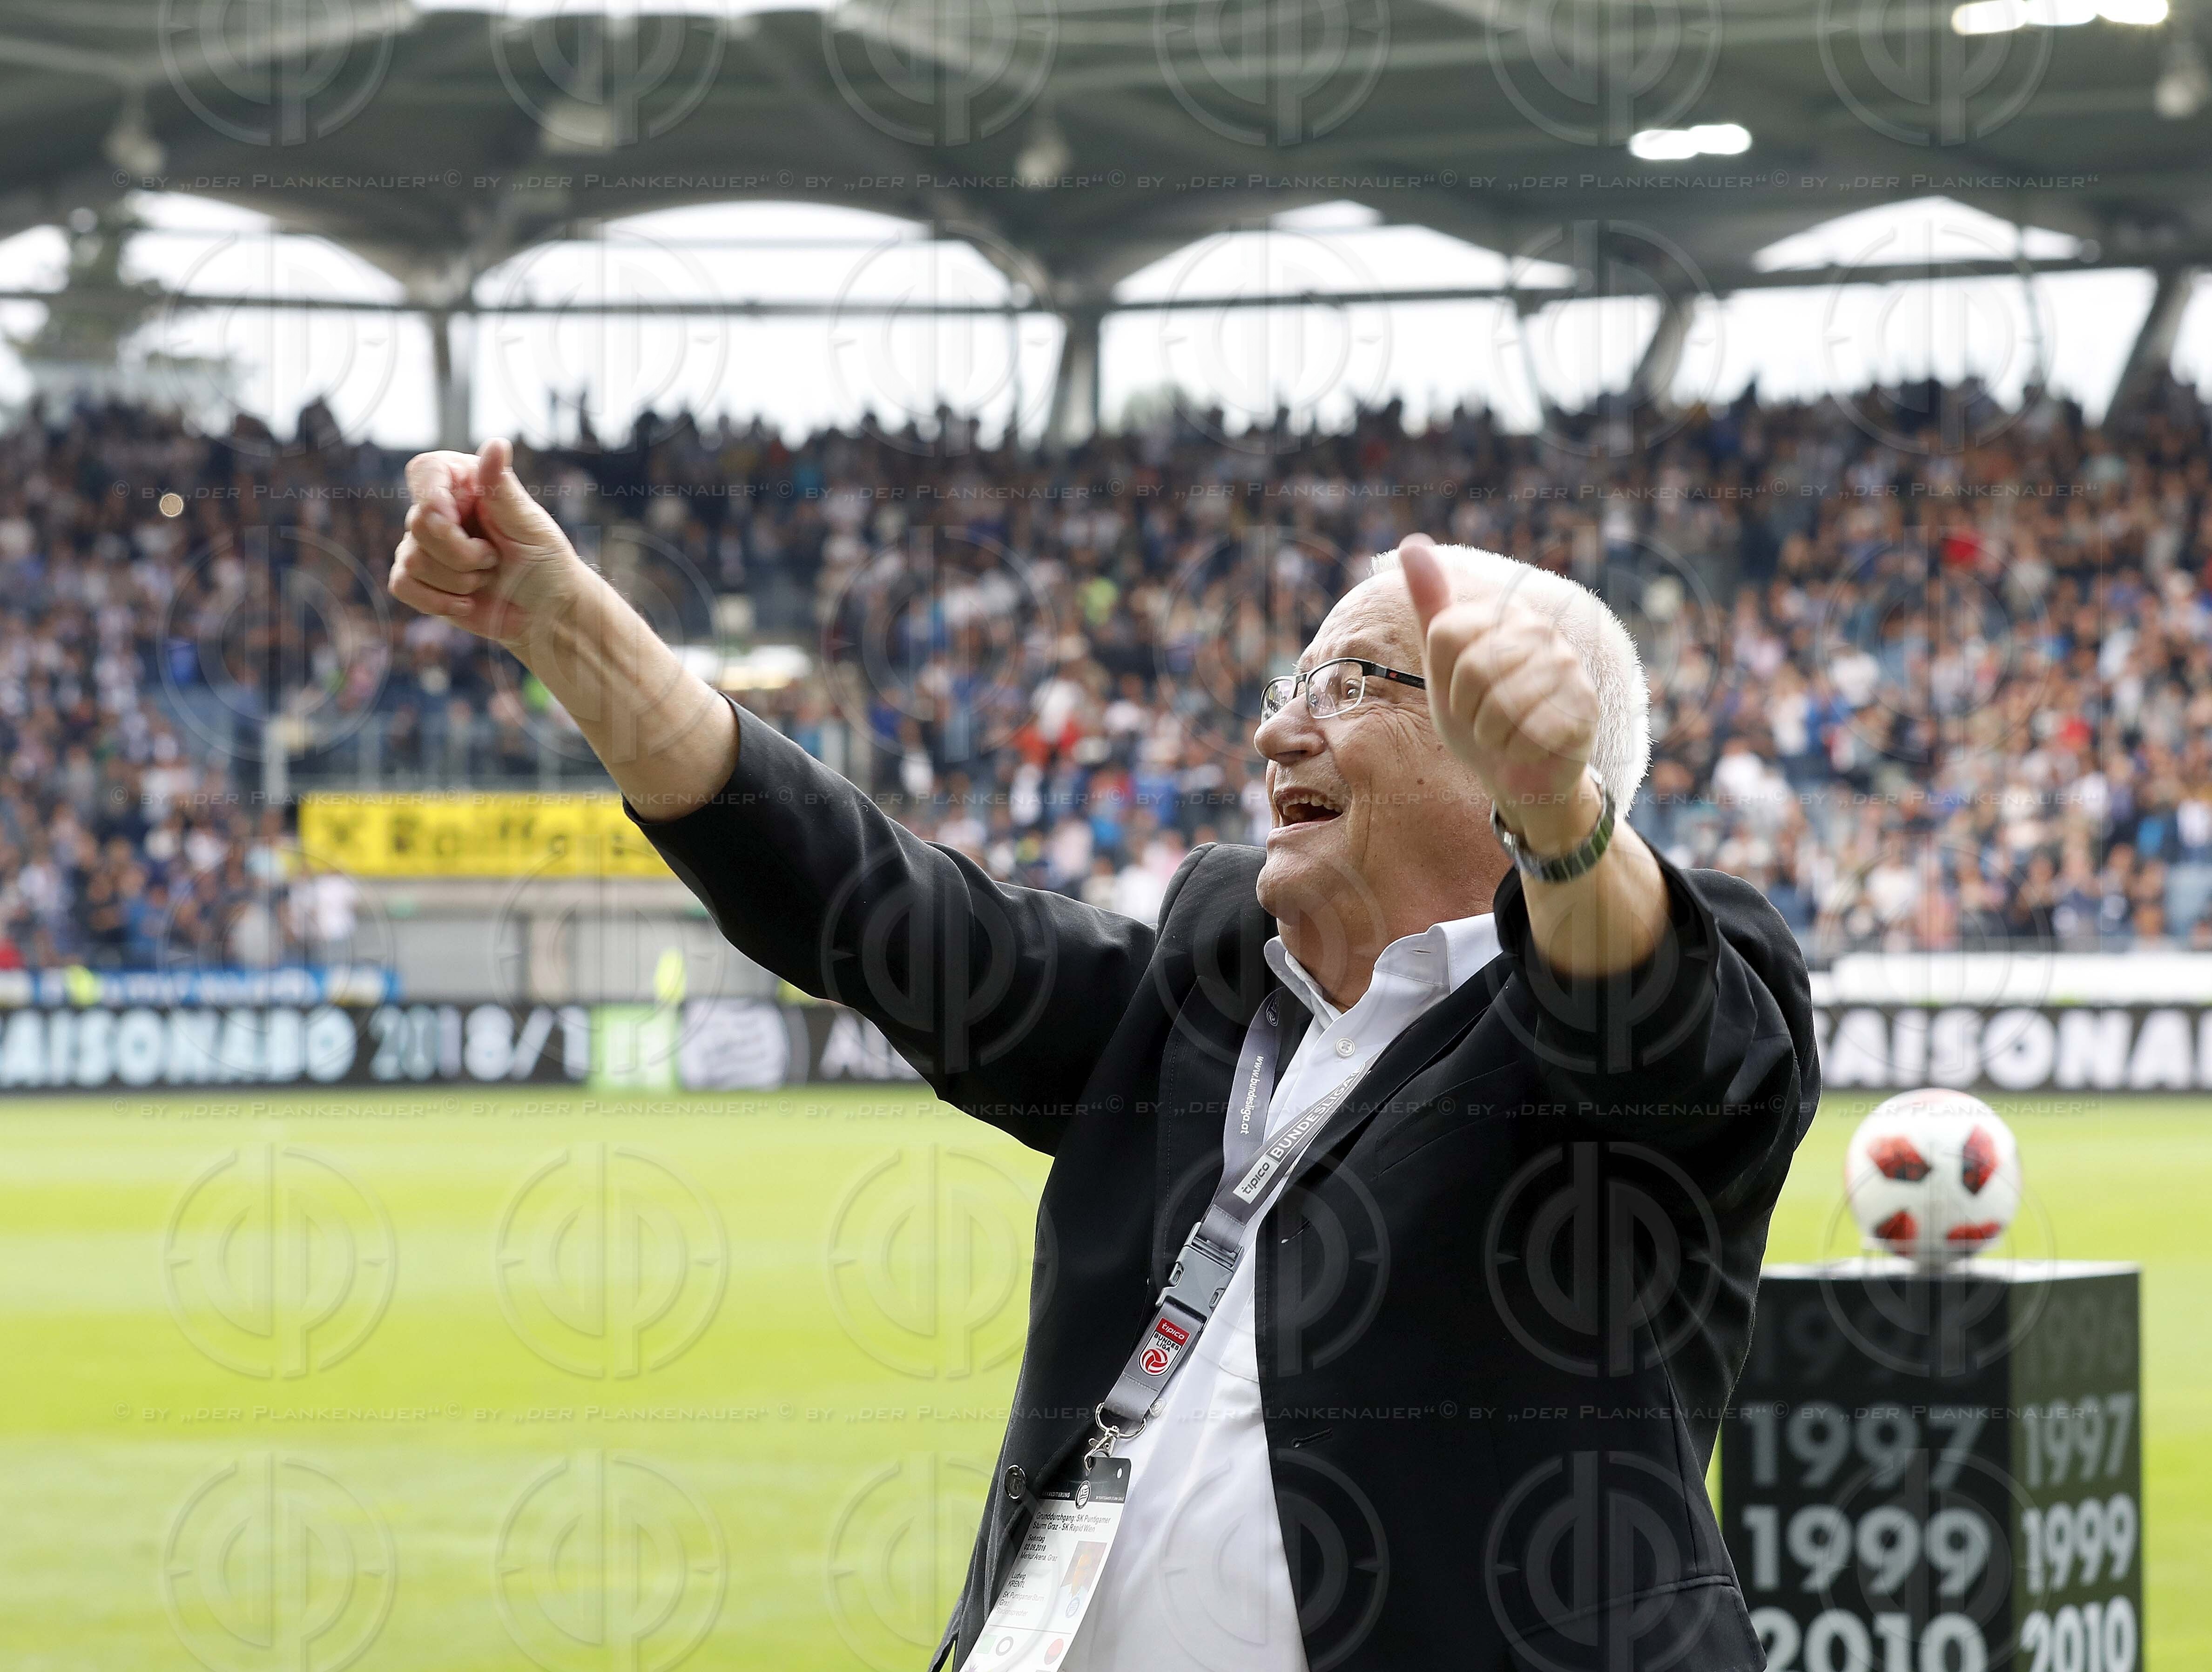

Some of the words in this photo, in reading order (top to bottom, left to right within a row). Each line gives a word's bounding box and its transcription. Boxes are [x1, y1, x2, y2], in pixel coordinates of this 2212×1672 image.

[1240, 1055, 1264, 1135] www.bundesliga.at
[1241, 1162, 1270, 1195] tipico
[1269, 1077, 1353, 1159] BUNDESLIGA
[1153, 1332, 1180, 1350] BUNDES
[1155, 1340, 1171, 1353] LIGA
[1161, 1322, 1185, 1340] tipico
[1741, 1400, 1990, 1489] 1997
[2019, 1391, 2136, 1489] 1997
[1027, 1534, 1045, 1543] Sonntag
[1032, 1521, 1046, 1530] Sturm
[1069, 1524, 1083, 1533] Rapid
[1741, 1503, 1992, 1598] 1999
[2019, 1493, 2137, 1595] 1999
[1749, 1606, 1989, 1672] 2010
[2019, 1595, 2138, 1672] 2010
